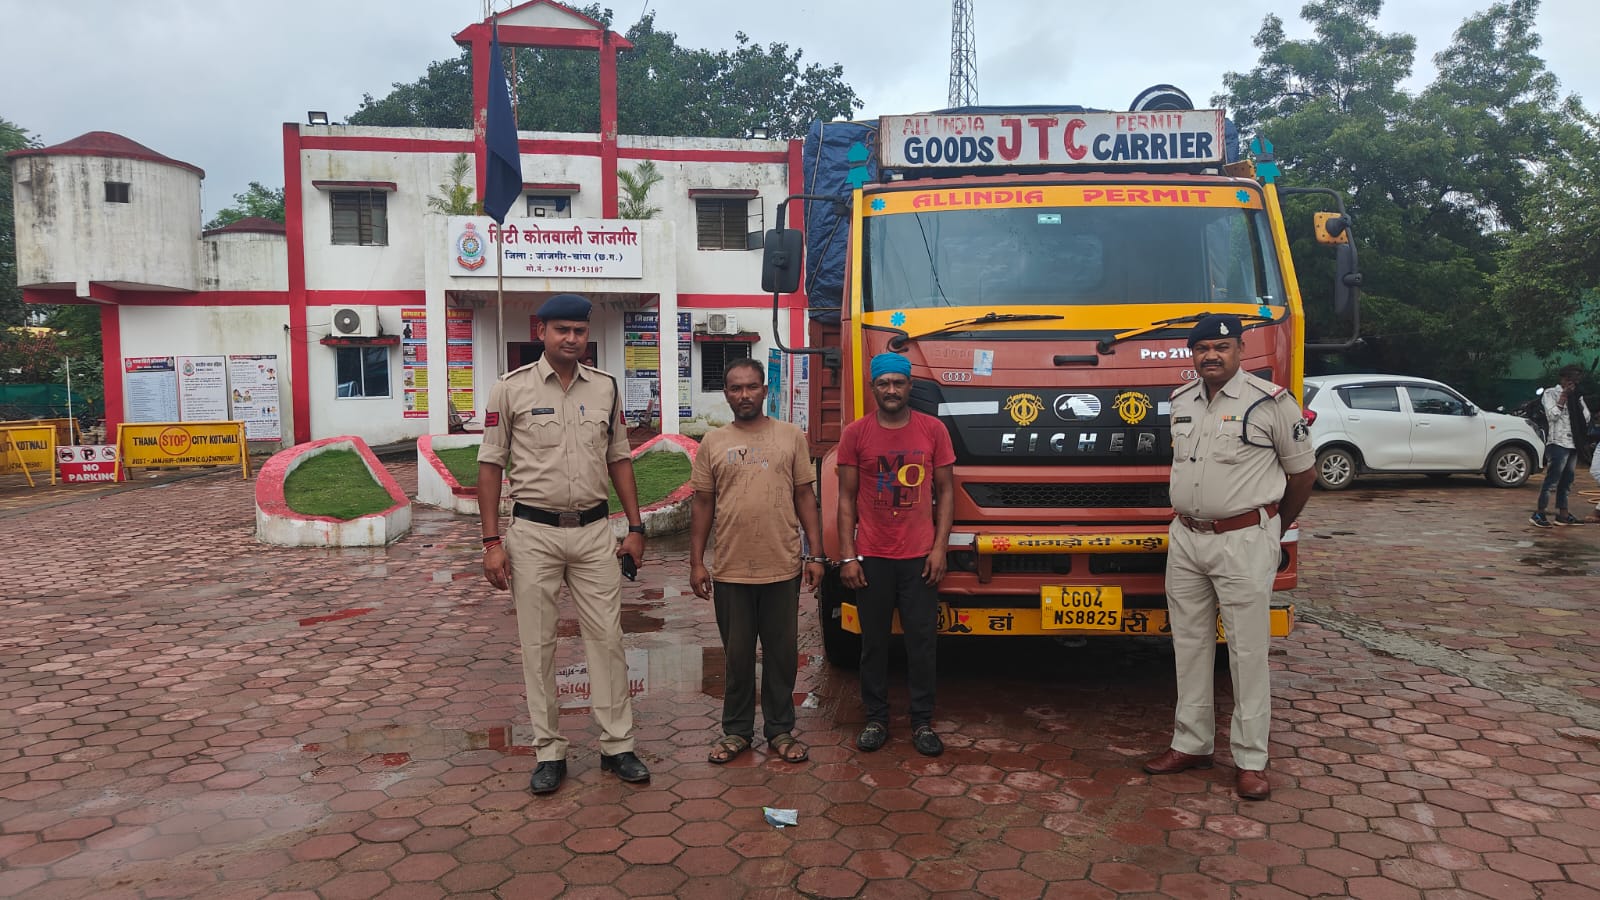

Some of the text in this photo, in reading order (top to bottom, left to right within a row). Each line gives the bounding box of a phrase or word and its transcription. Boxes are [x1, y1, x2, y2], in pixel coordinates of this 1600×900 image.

[902, 114, 1182, 135] ALL INDIA PERMIT
[904, 136, 995, 164] GOODS
[1093, 131, 1213, 161] CARRIER
[1083, 189, 1212, 204] PERMIT
[523, 224, 583, 245] कोतवाली
[587, 225, 637, 246] जांजगीर
[505, 249, 526, 260] जिला
[1141, 348, 1167, 360] Pro
[132, 434, 238, 447] THANA STOP CITY KOTWALI
[1000, 432, 1156, 454] EICHER
[82, 463, 99, 472] NO
[1061, 587, 1103, 608] CG04
[1054, 610, 1118, 626] NS8825
